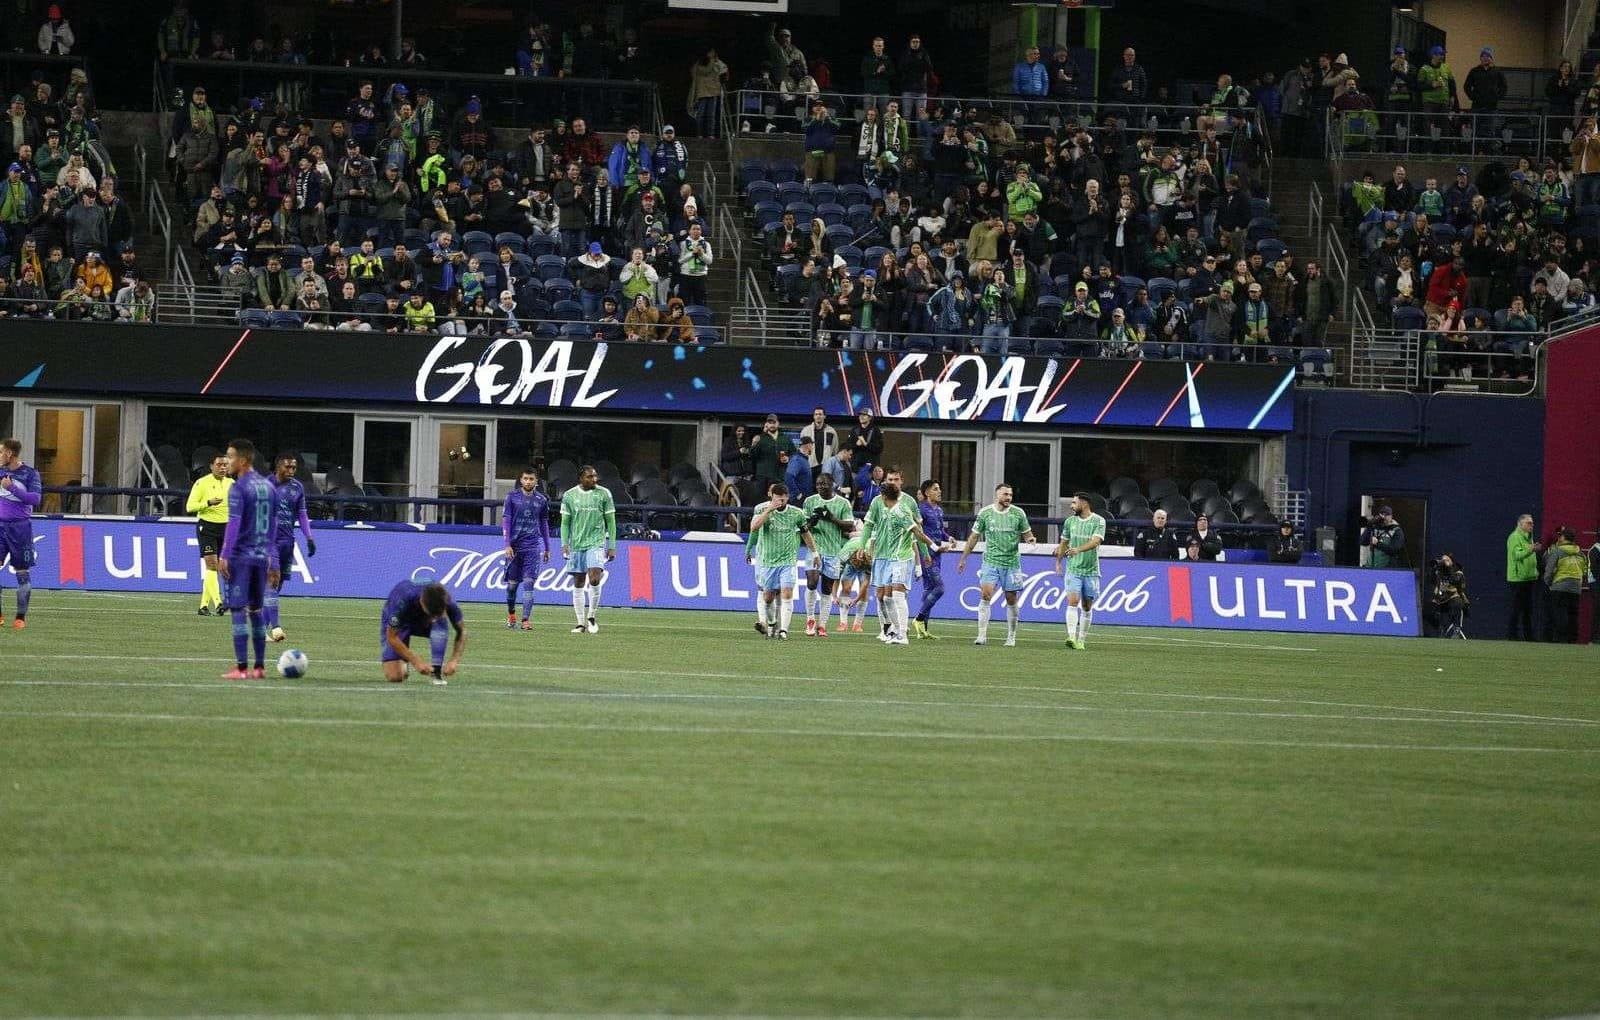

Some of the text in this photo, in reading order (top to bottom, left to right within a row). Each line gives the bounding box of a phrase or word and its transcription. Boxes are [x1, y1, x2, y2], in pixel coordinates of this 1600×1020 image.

[415, 336, 618, 407] GOAL
[880, 352, 1067, 423] GOAL
[1208, 575, 1402, 624] ULTRA
